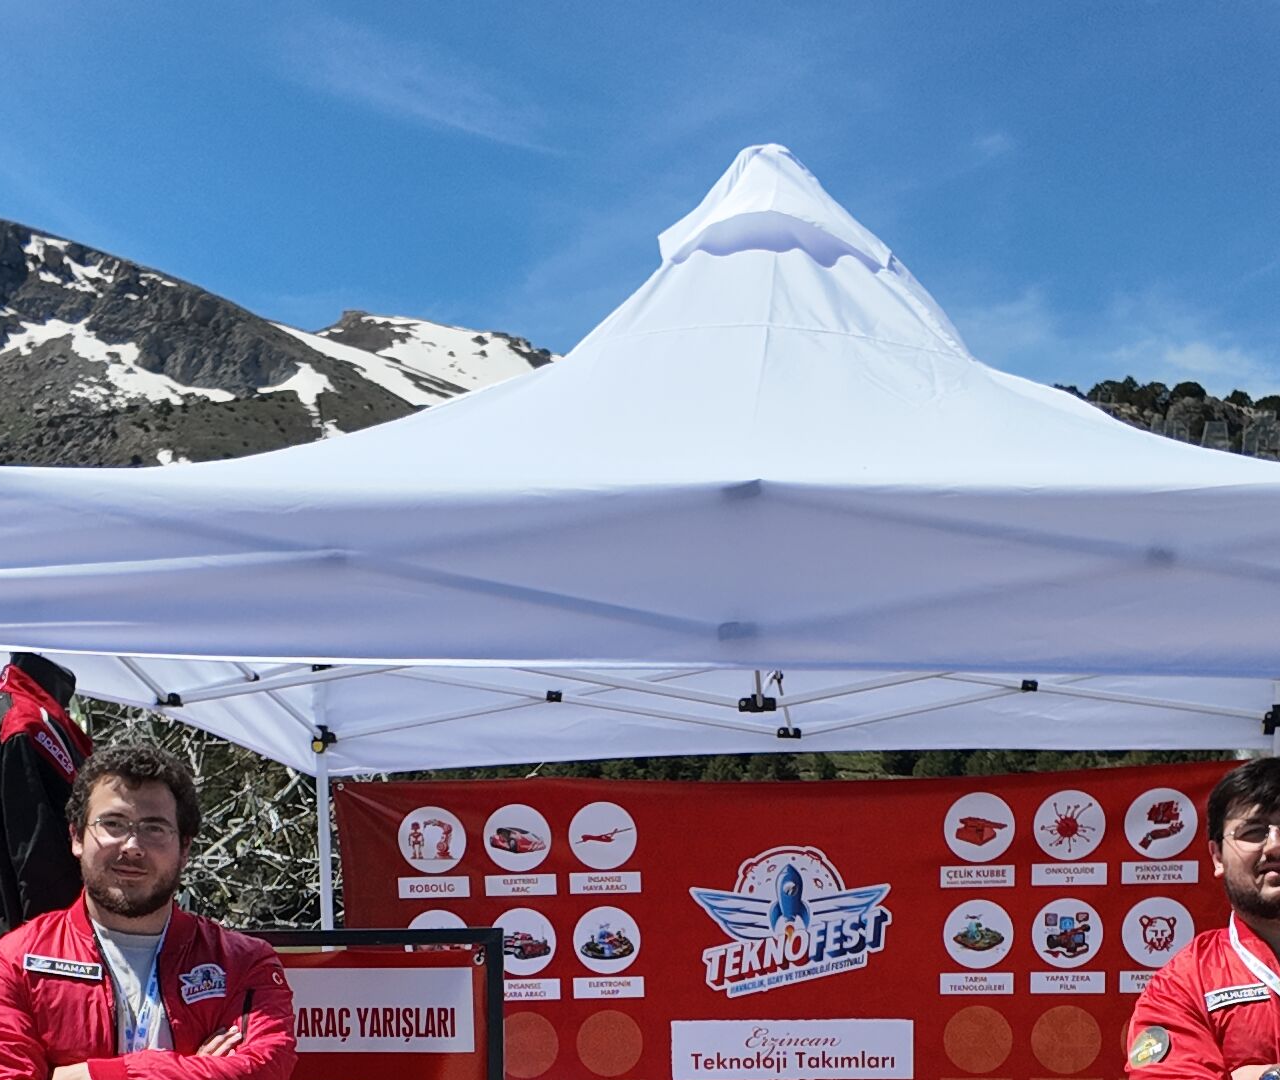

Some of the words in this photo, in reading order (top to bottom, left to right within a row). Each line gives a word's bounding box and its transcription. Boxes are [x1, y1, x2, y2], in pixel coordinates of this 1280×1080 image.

[946, 868, 973, 880] ÇELİK
[975, 869, 1007, 879] KUBBE
[1136, 873, 1161, 881] YAPAY
[408, 882, 456, 893] ROBOLİG
[705, 907, 886, 983] TEKNOFEST
[296, 1007, 351, 1043] ARAÇ
[356, 1007, 456, 1043] YARIŞLARI
[690, 1051, 788, 1074] Teknoloji
[794, 1050, 896, 1069] Takımları
